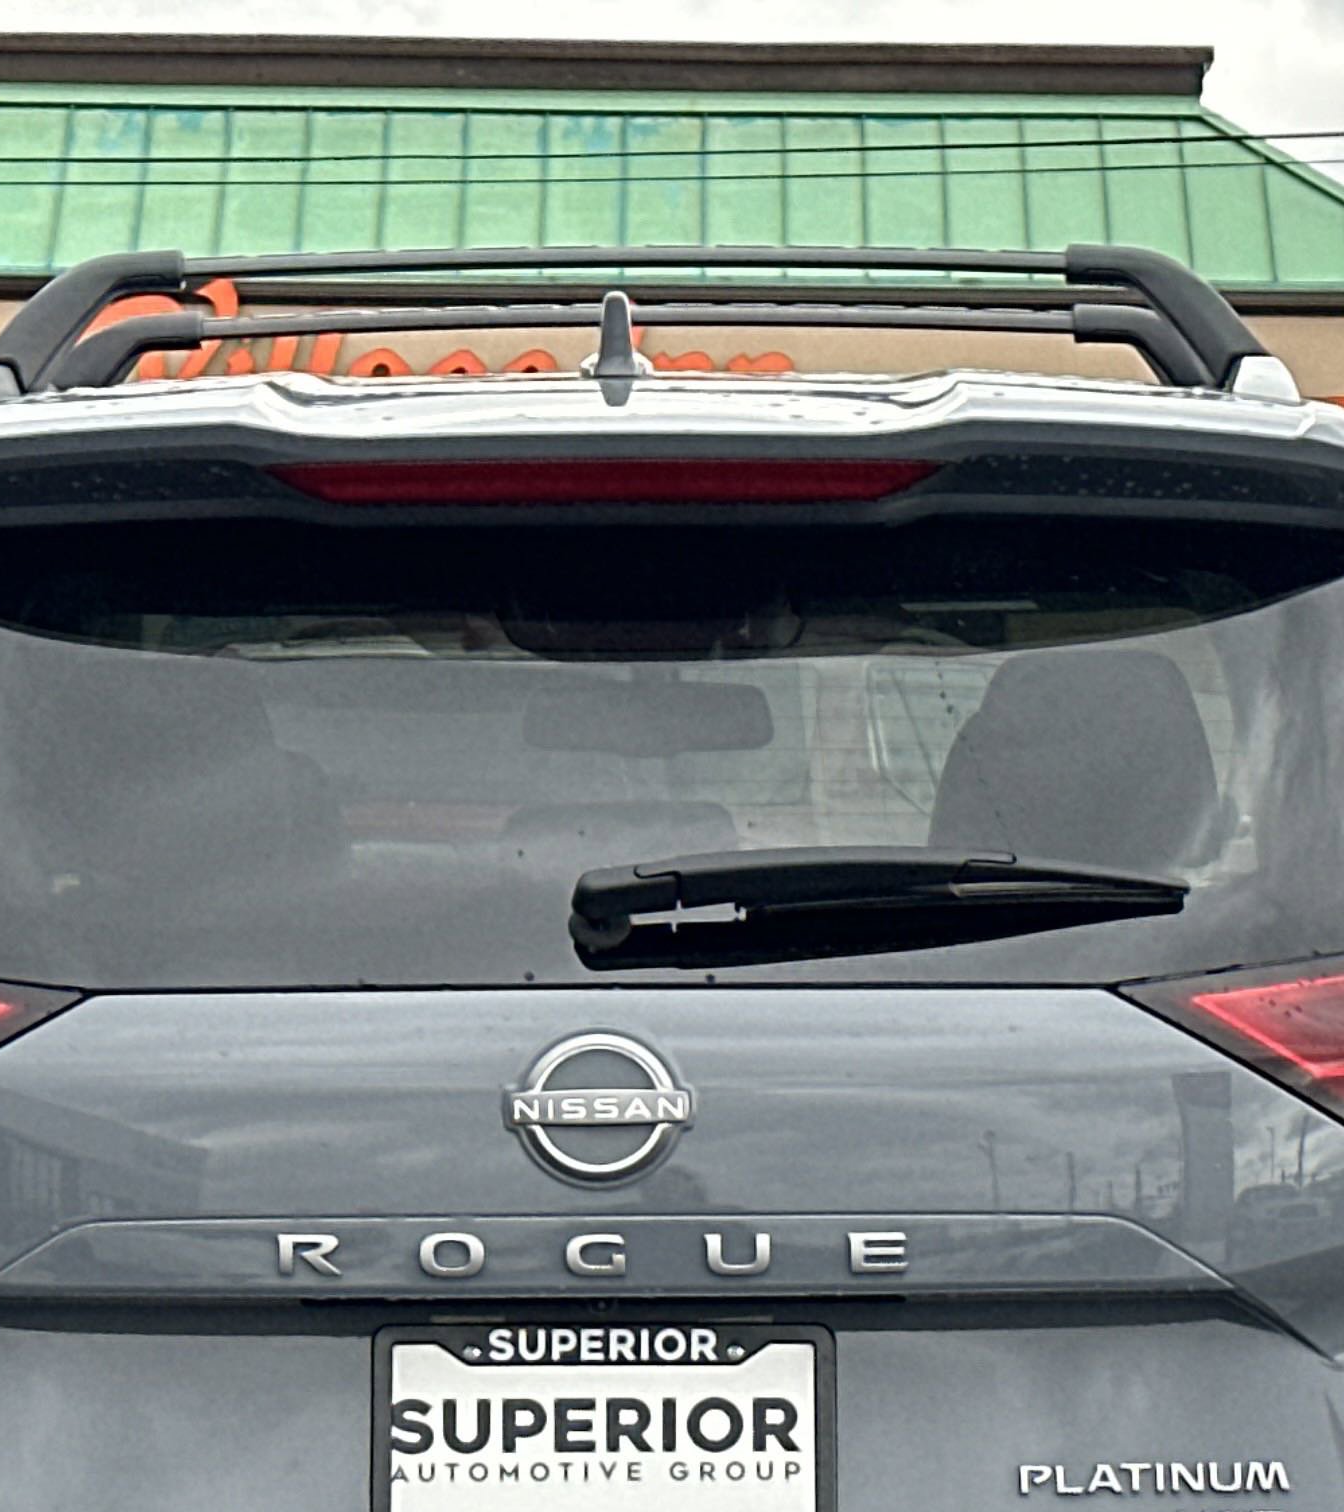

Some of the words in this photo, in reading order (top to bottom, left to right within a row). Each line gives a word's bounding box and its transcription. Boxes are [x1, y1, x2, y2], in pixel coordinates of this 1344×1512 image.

[513, 1098, 687, 1121] NISSAN
[276, 1232, 910, 1277] ROGUE
[489, 1329, 718, 1362] SUPERIOR
[391, 1397, 802, 1454] SUPERIOR
[391, 1462, 643, 1483] AUTOMOTIVE
[669, 1461, 802, 1482] GROUP
[1018, 1461, 1291, 1494] PLATINUM
